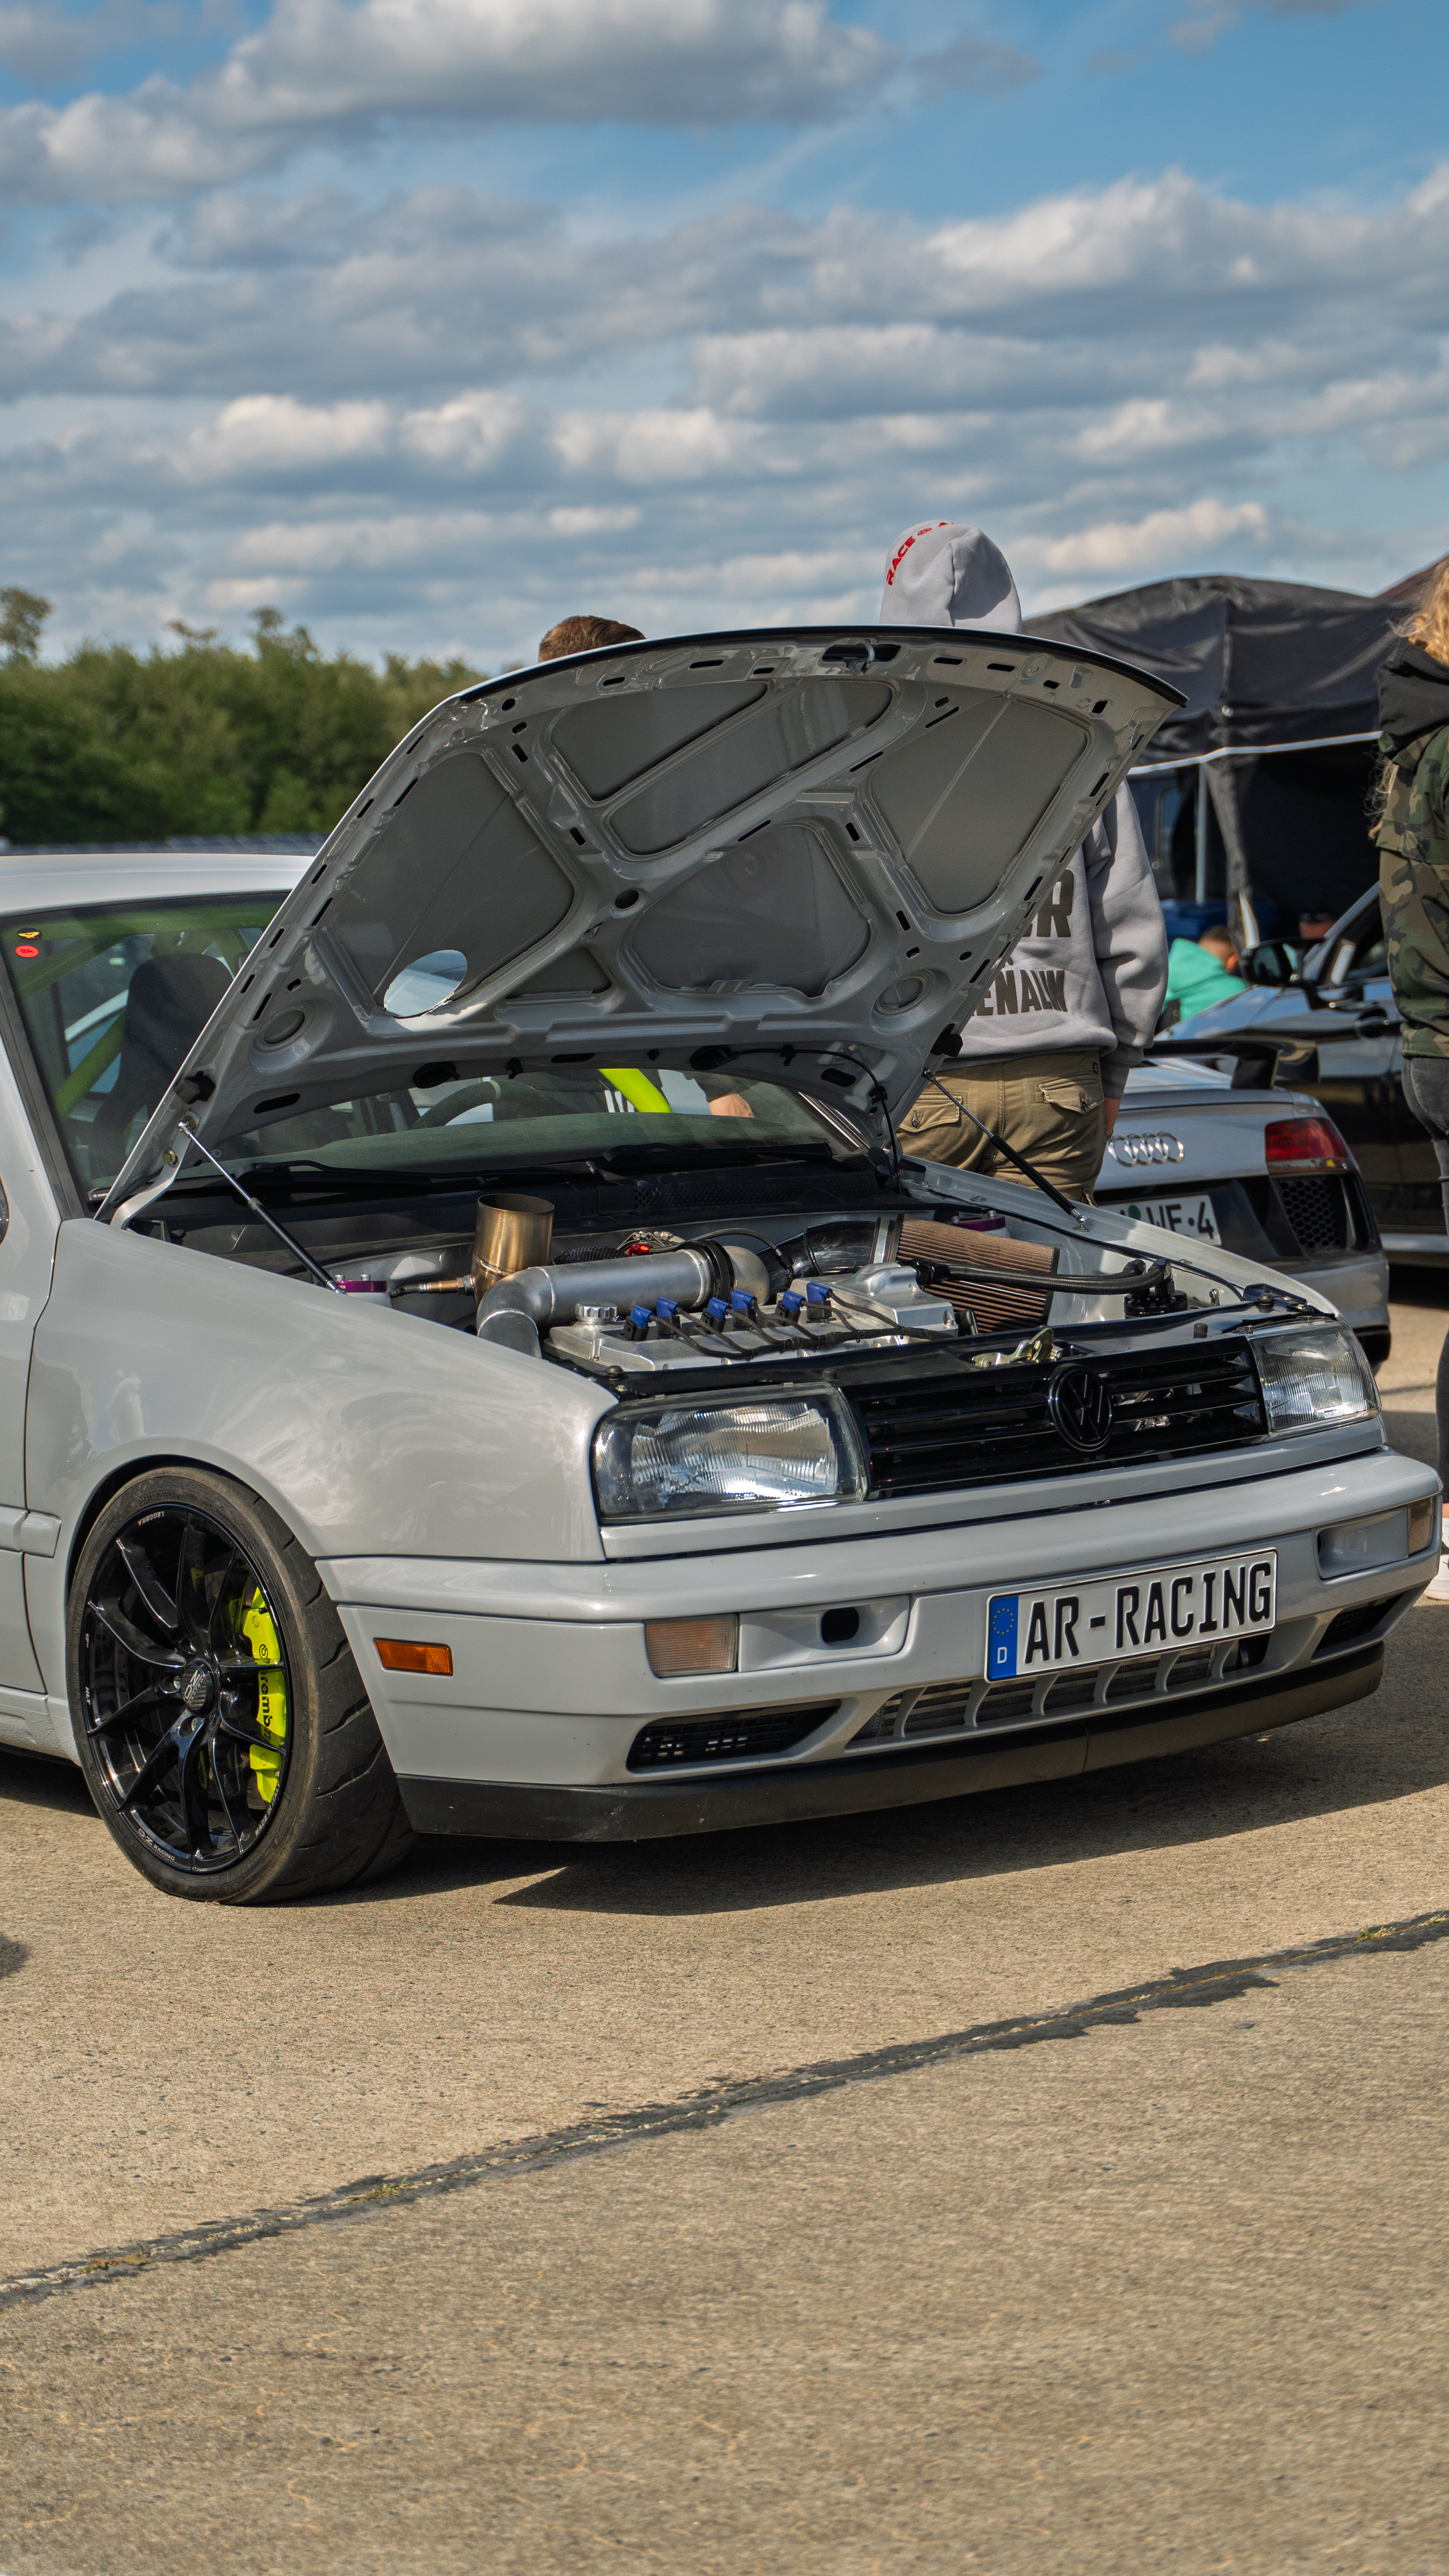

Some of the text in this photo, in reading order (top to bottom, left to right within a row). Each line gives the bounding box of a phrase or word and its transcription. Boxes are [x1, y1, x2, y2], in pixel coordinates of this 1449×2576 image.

[886, 528, 933, 586] RACE @
[1197, 1201, 1214, 1239] 4
[138, 1511, 164, 1525] LEGGERA
[1024, 1561, 1271, 1664] AR-RACING
[997, 1646, 1007, 1664] D
[255, 1780, 280, 1836] MADE IN ITALY
[153, 1844, 175, 1861] RACING
